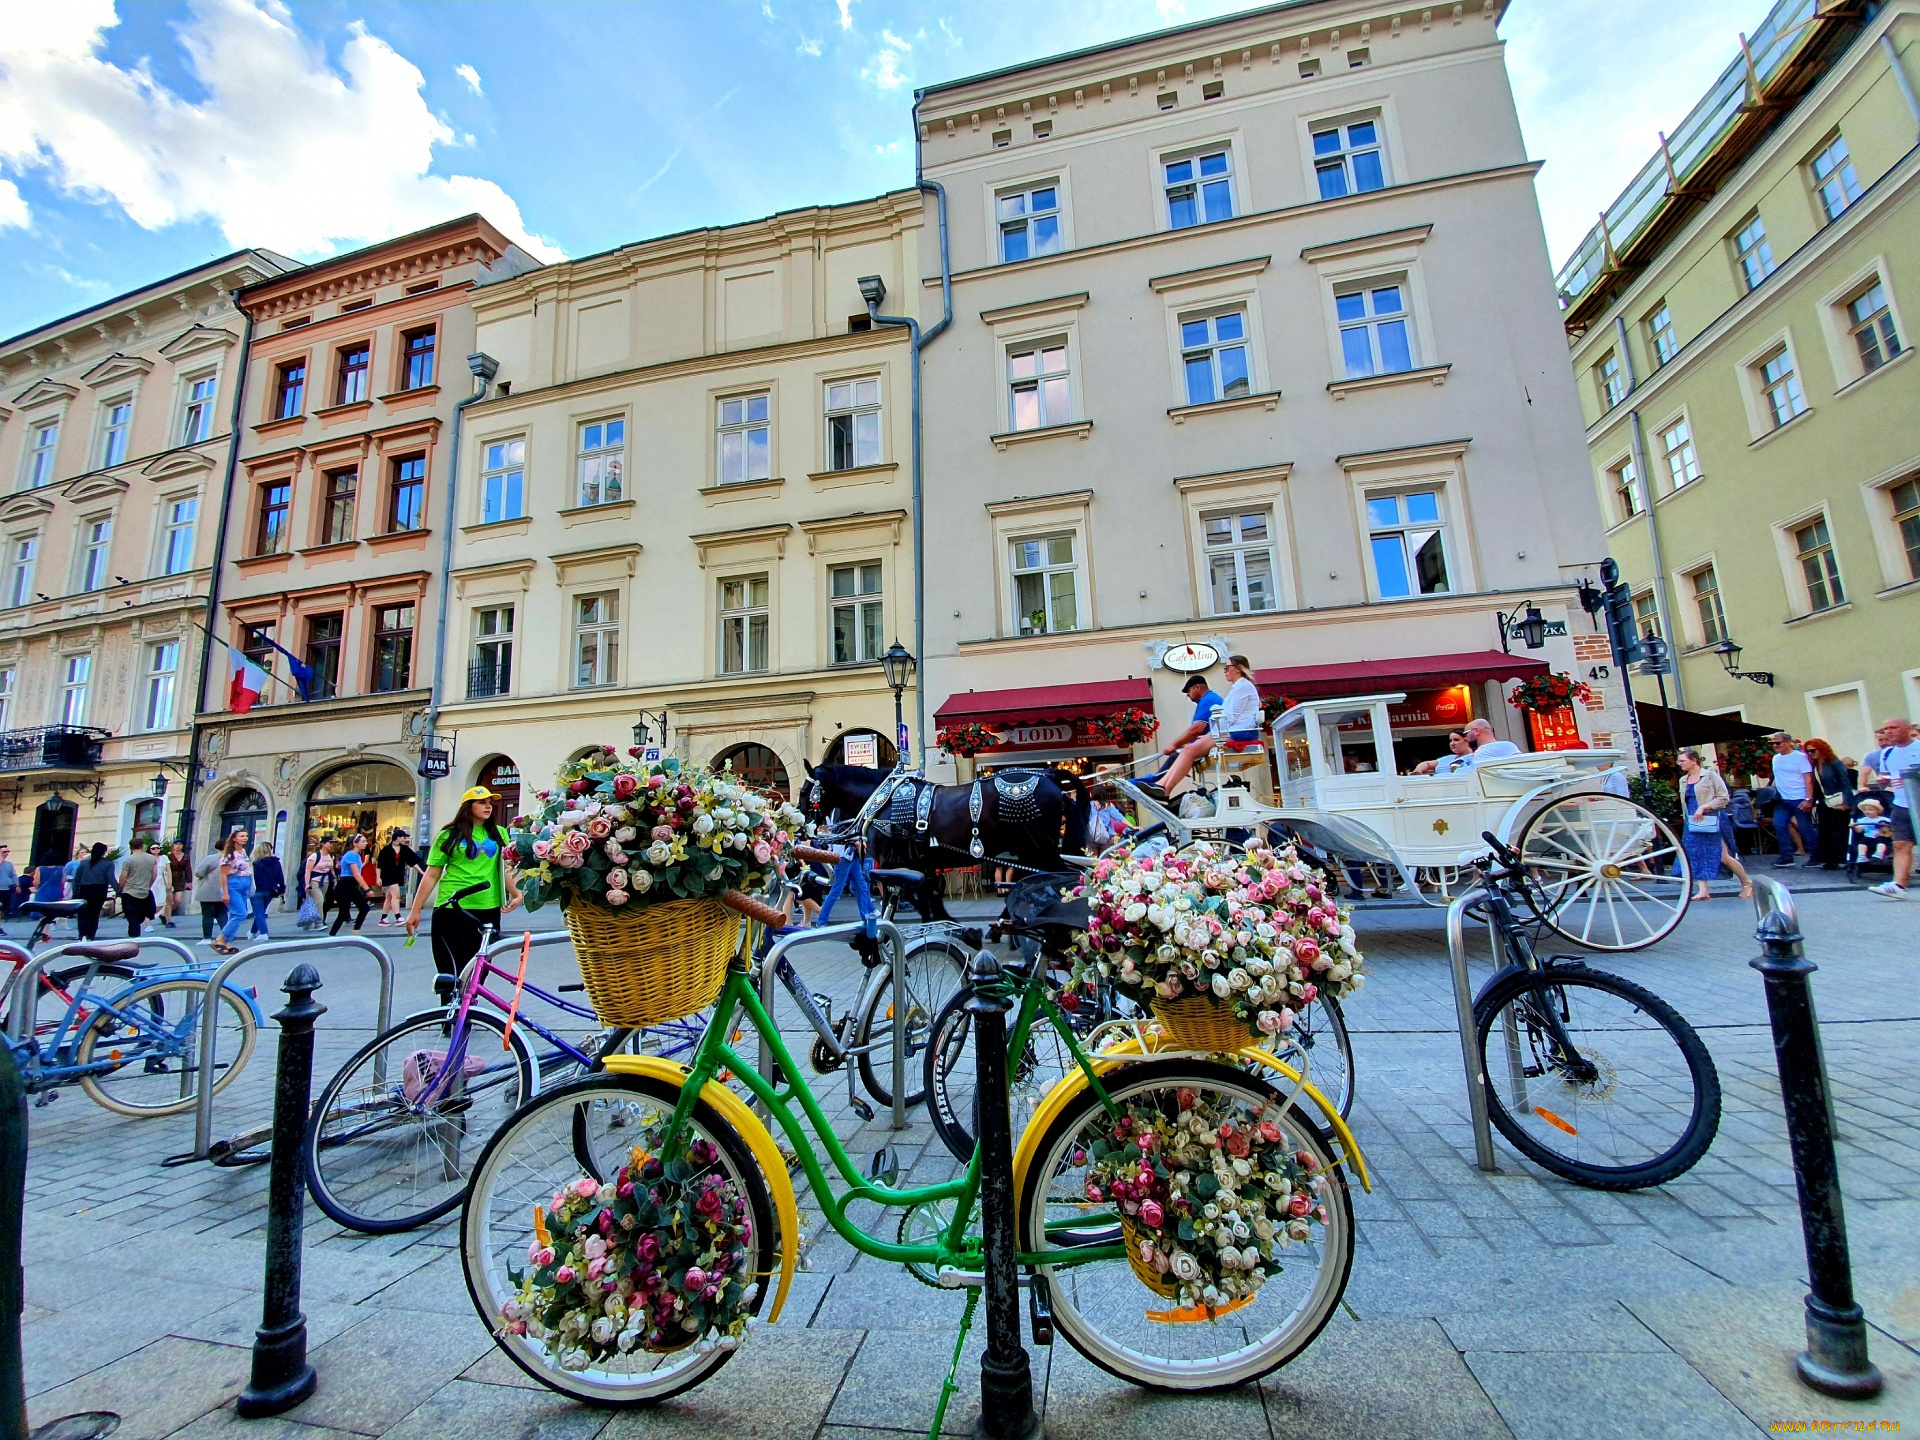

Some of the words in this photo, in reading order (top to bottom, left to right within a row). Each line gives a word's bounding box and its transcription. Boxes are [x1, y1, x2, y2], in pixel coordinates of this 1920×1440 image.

[1512, 626, 1566, 638] GZKA
[1189, 650, 1213, 661] Mini
[1589, 665, 1609, 680] 45
[1357, 710, 1430, 725] Kiarnia
[1018, 726, 1066, 742] LODY
[850, 743, 871, 751] SWEET
[648, 752, 657, 760] 47
[427, 760, 446, 770] BAR
